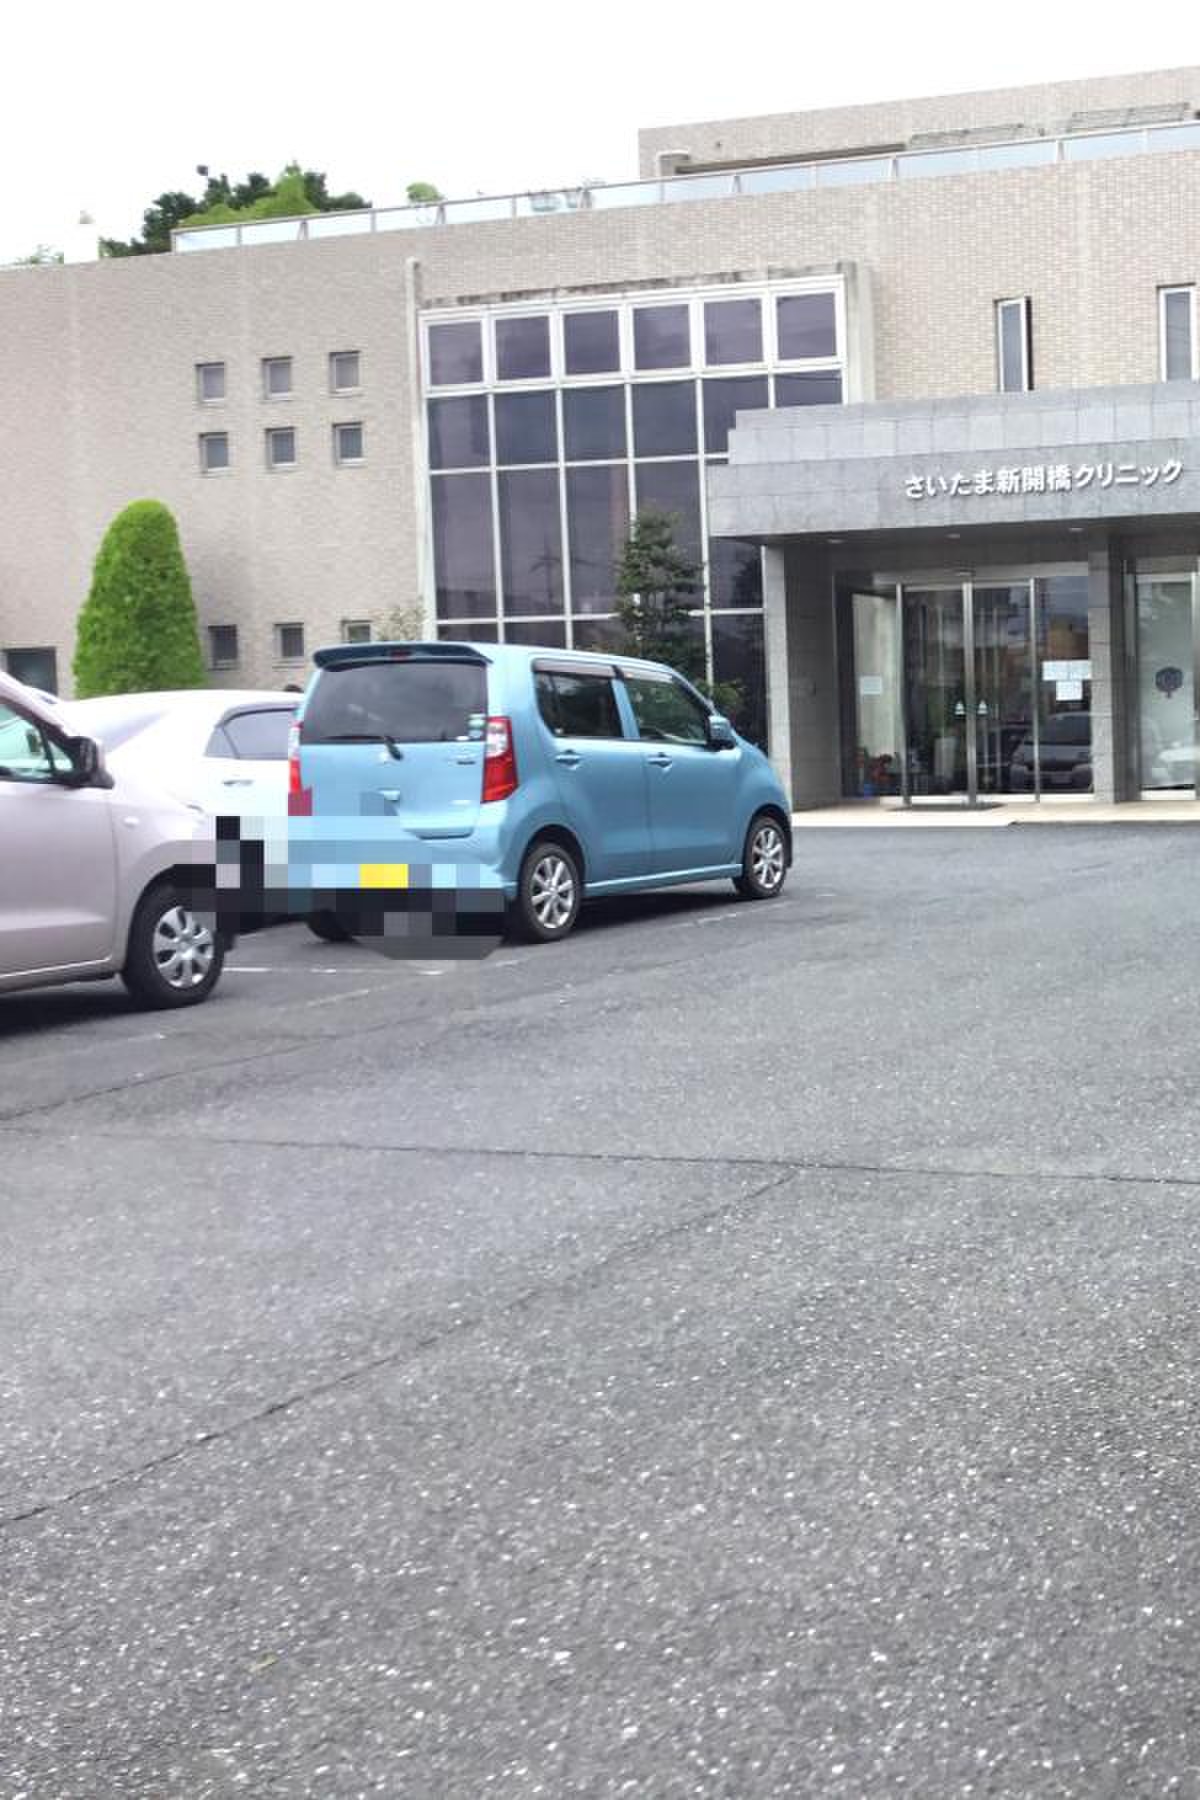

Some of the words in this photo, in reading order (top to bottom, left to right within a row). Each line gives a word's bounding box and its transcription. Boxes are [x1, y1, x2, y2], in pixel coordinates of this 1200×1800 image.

[905, 459, 1183, 498] さいたま新開橋クリニック
